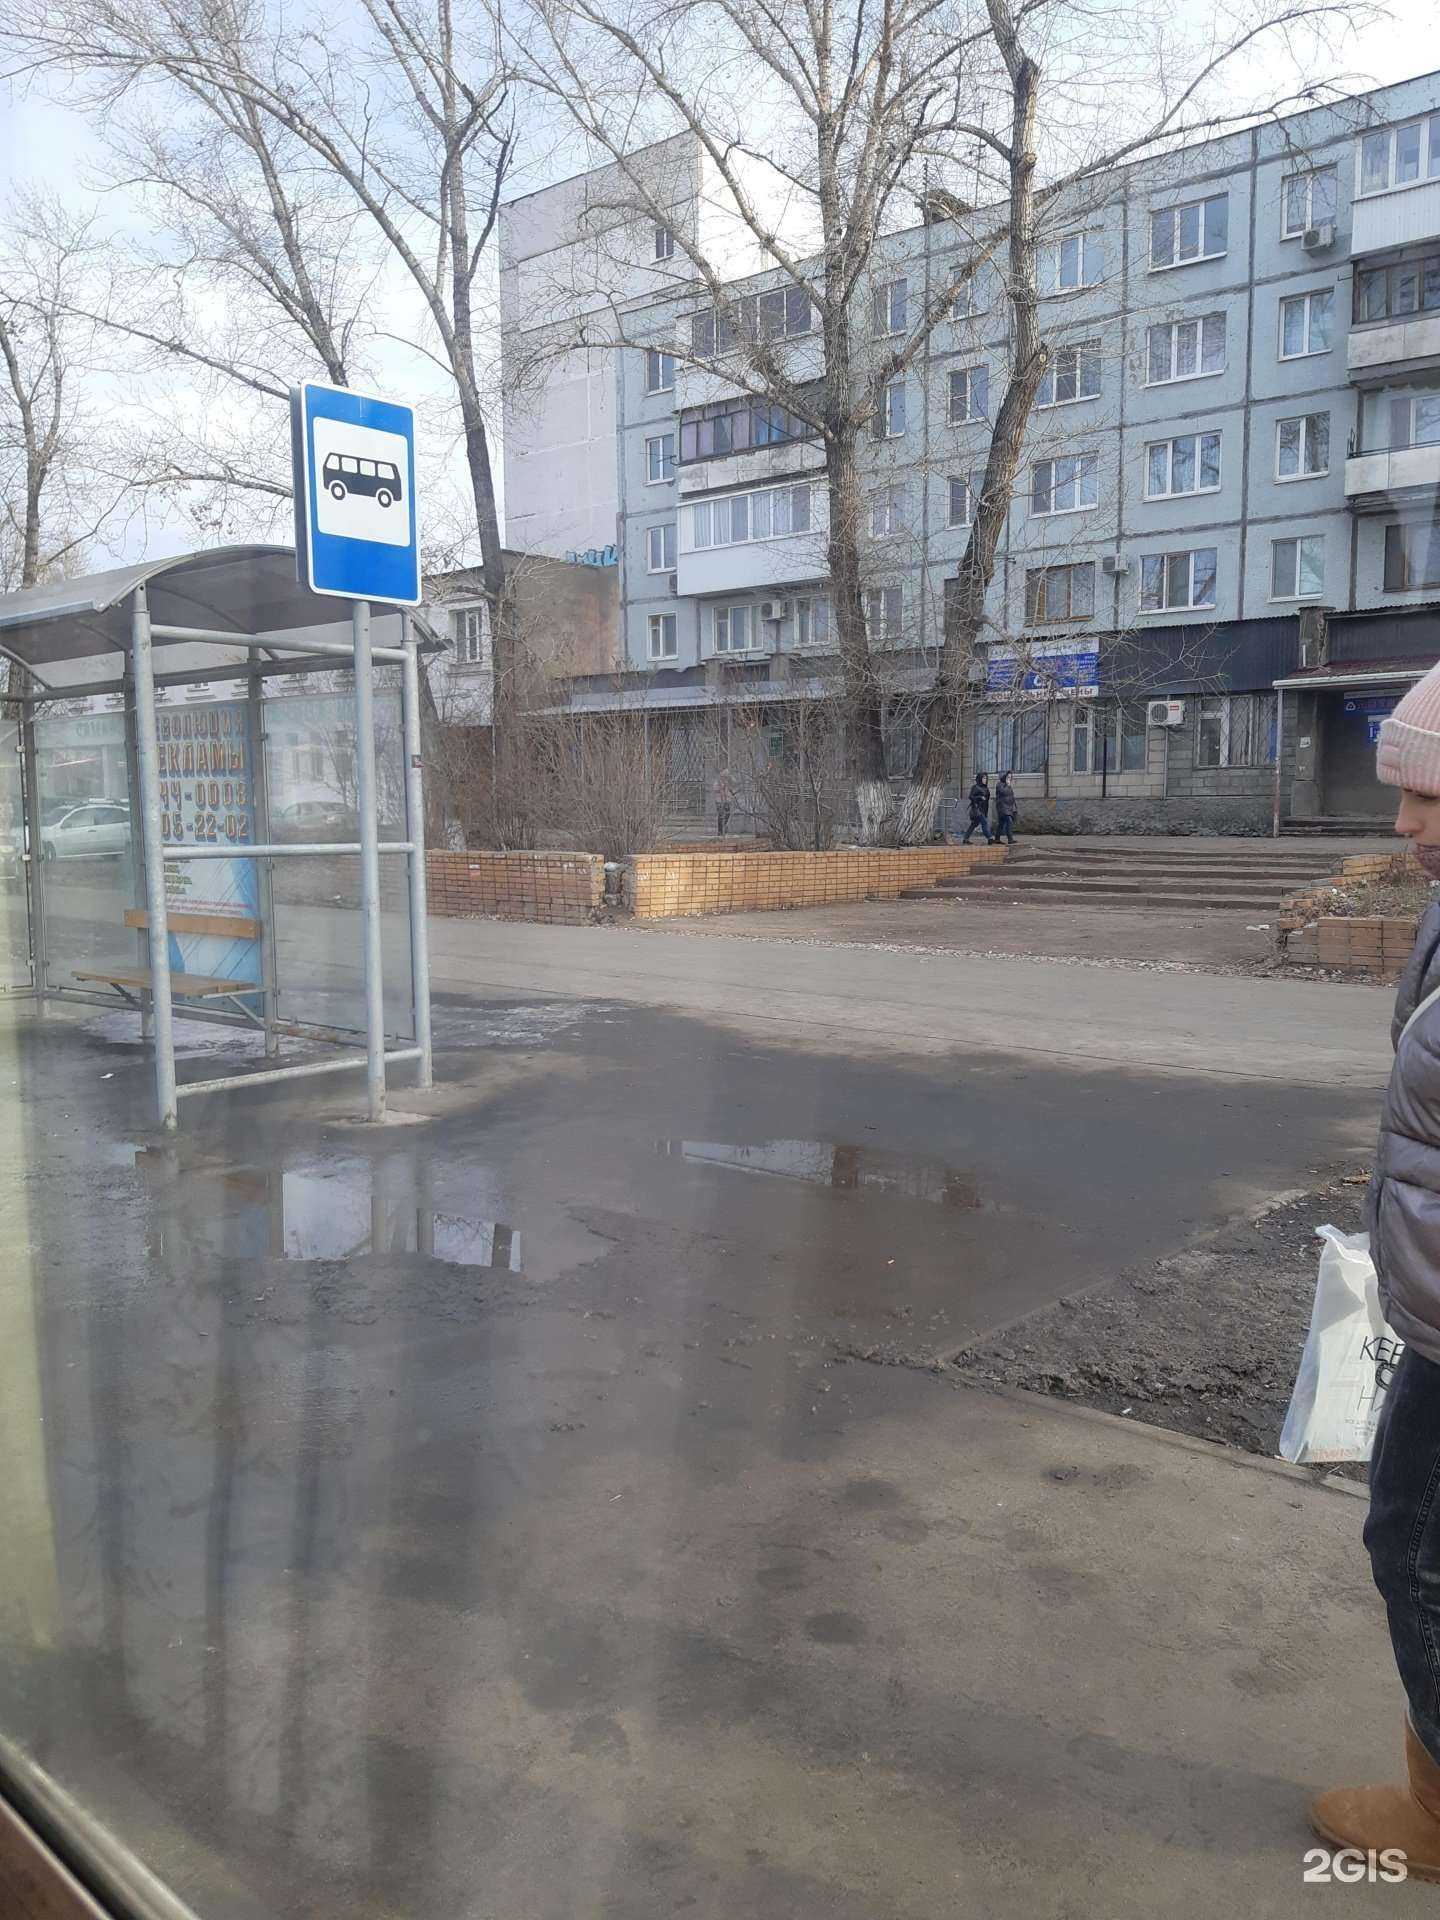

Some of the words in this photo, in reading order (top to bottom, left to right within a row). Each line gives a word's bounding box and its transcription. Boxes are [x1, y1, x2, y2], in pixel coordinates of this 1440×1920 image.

[156, 711, 245, 741] ВОЛЮЦИЯ
[158, 742, 245, 777] ЕКЛАМЫ
[1357, 1385, 1384, 1412] H
